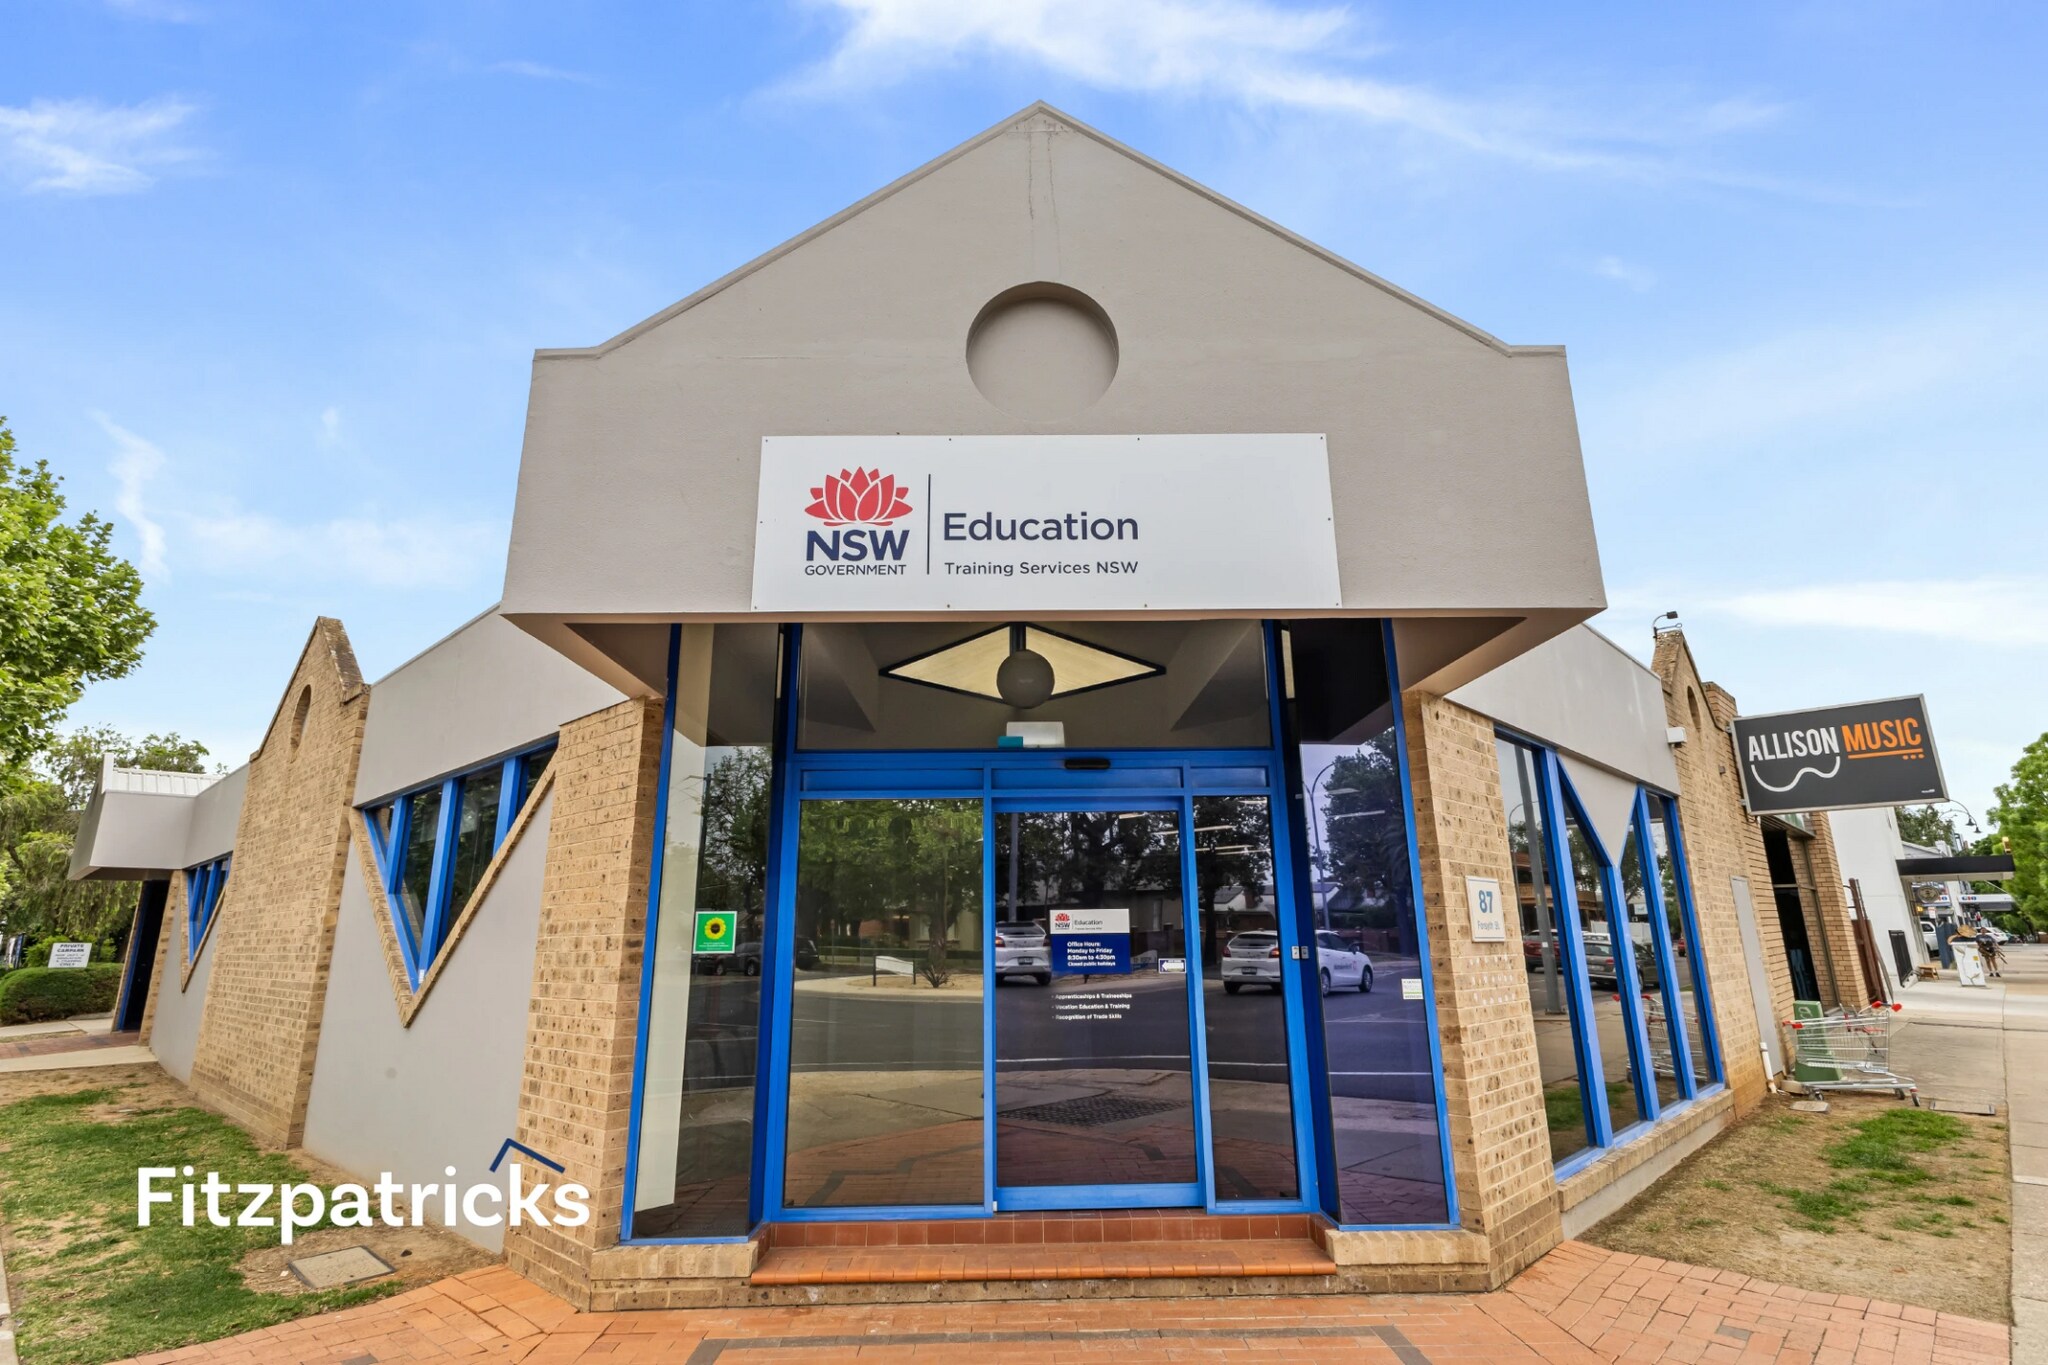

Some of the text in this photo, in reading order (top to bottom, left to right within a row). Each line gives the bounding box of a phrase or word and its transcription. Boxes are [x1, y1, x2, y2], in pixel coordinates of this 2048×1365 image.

[944, 511, 1139, 541] Education
[806, 529, 910, 561] NSW
[804, 564, 907, 576] GOVERNMENT
[944, 561, 1139, 577] Training Services NSW
[1748, 717, 1922, 762] ALLISON MUSIC
[1479, 890, 1492, 913] 87
